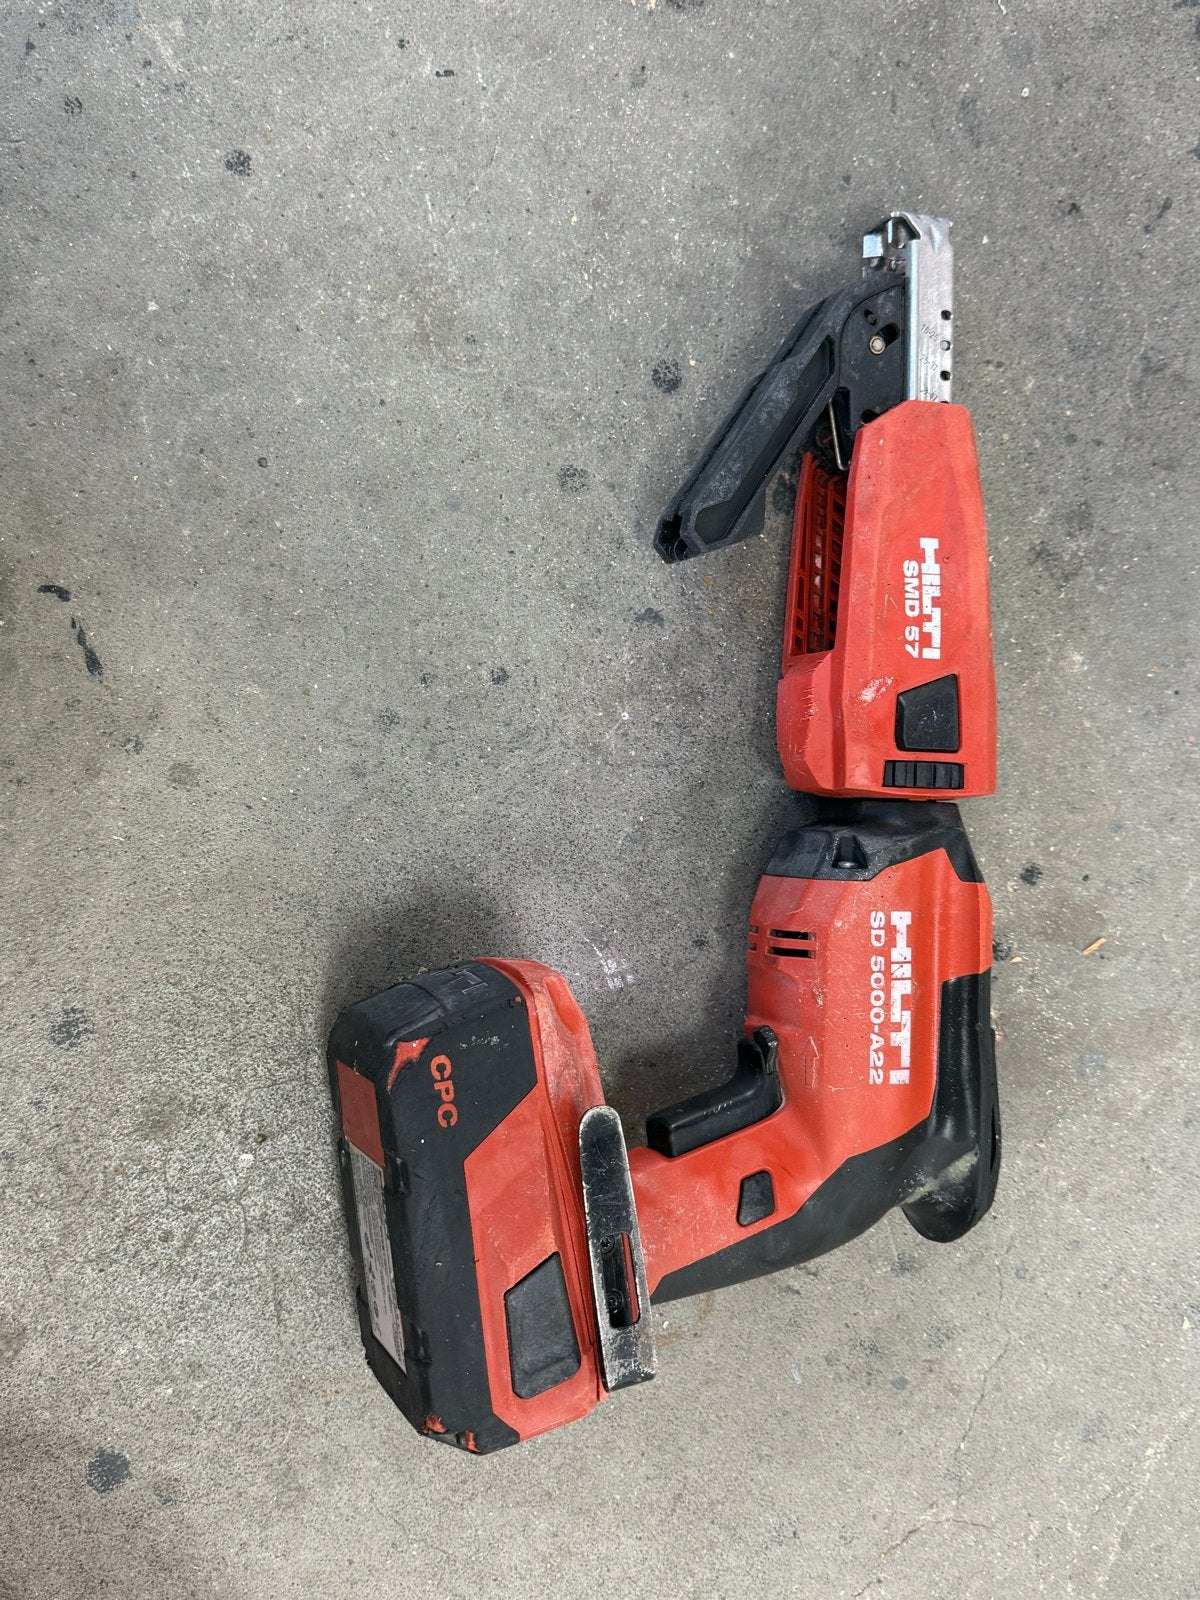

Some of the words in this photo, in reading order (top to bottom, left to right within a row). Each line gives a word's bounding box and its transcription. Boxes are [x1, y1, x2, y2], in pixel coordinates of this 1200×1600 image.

[903, 560, 920, 617] SMD
[920, 537, 941, 659] HILTI
[905, 626, 920, 658] 57
[870, 911, 886, 947] SD
[869, 955, 885, 1085] 5000-A22
[889, 911, 912, 1084] HILTI
[430, 1055, 458, 1128] CPC
